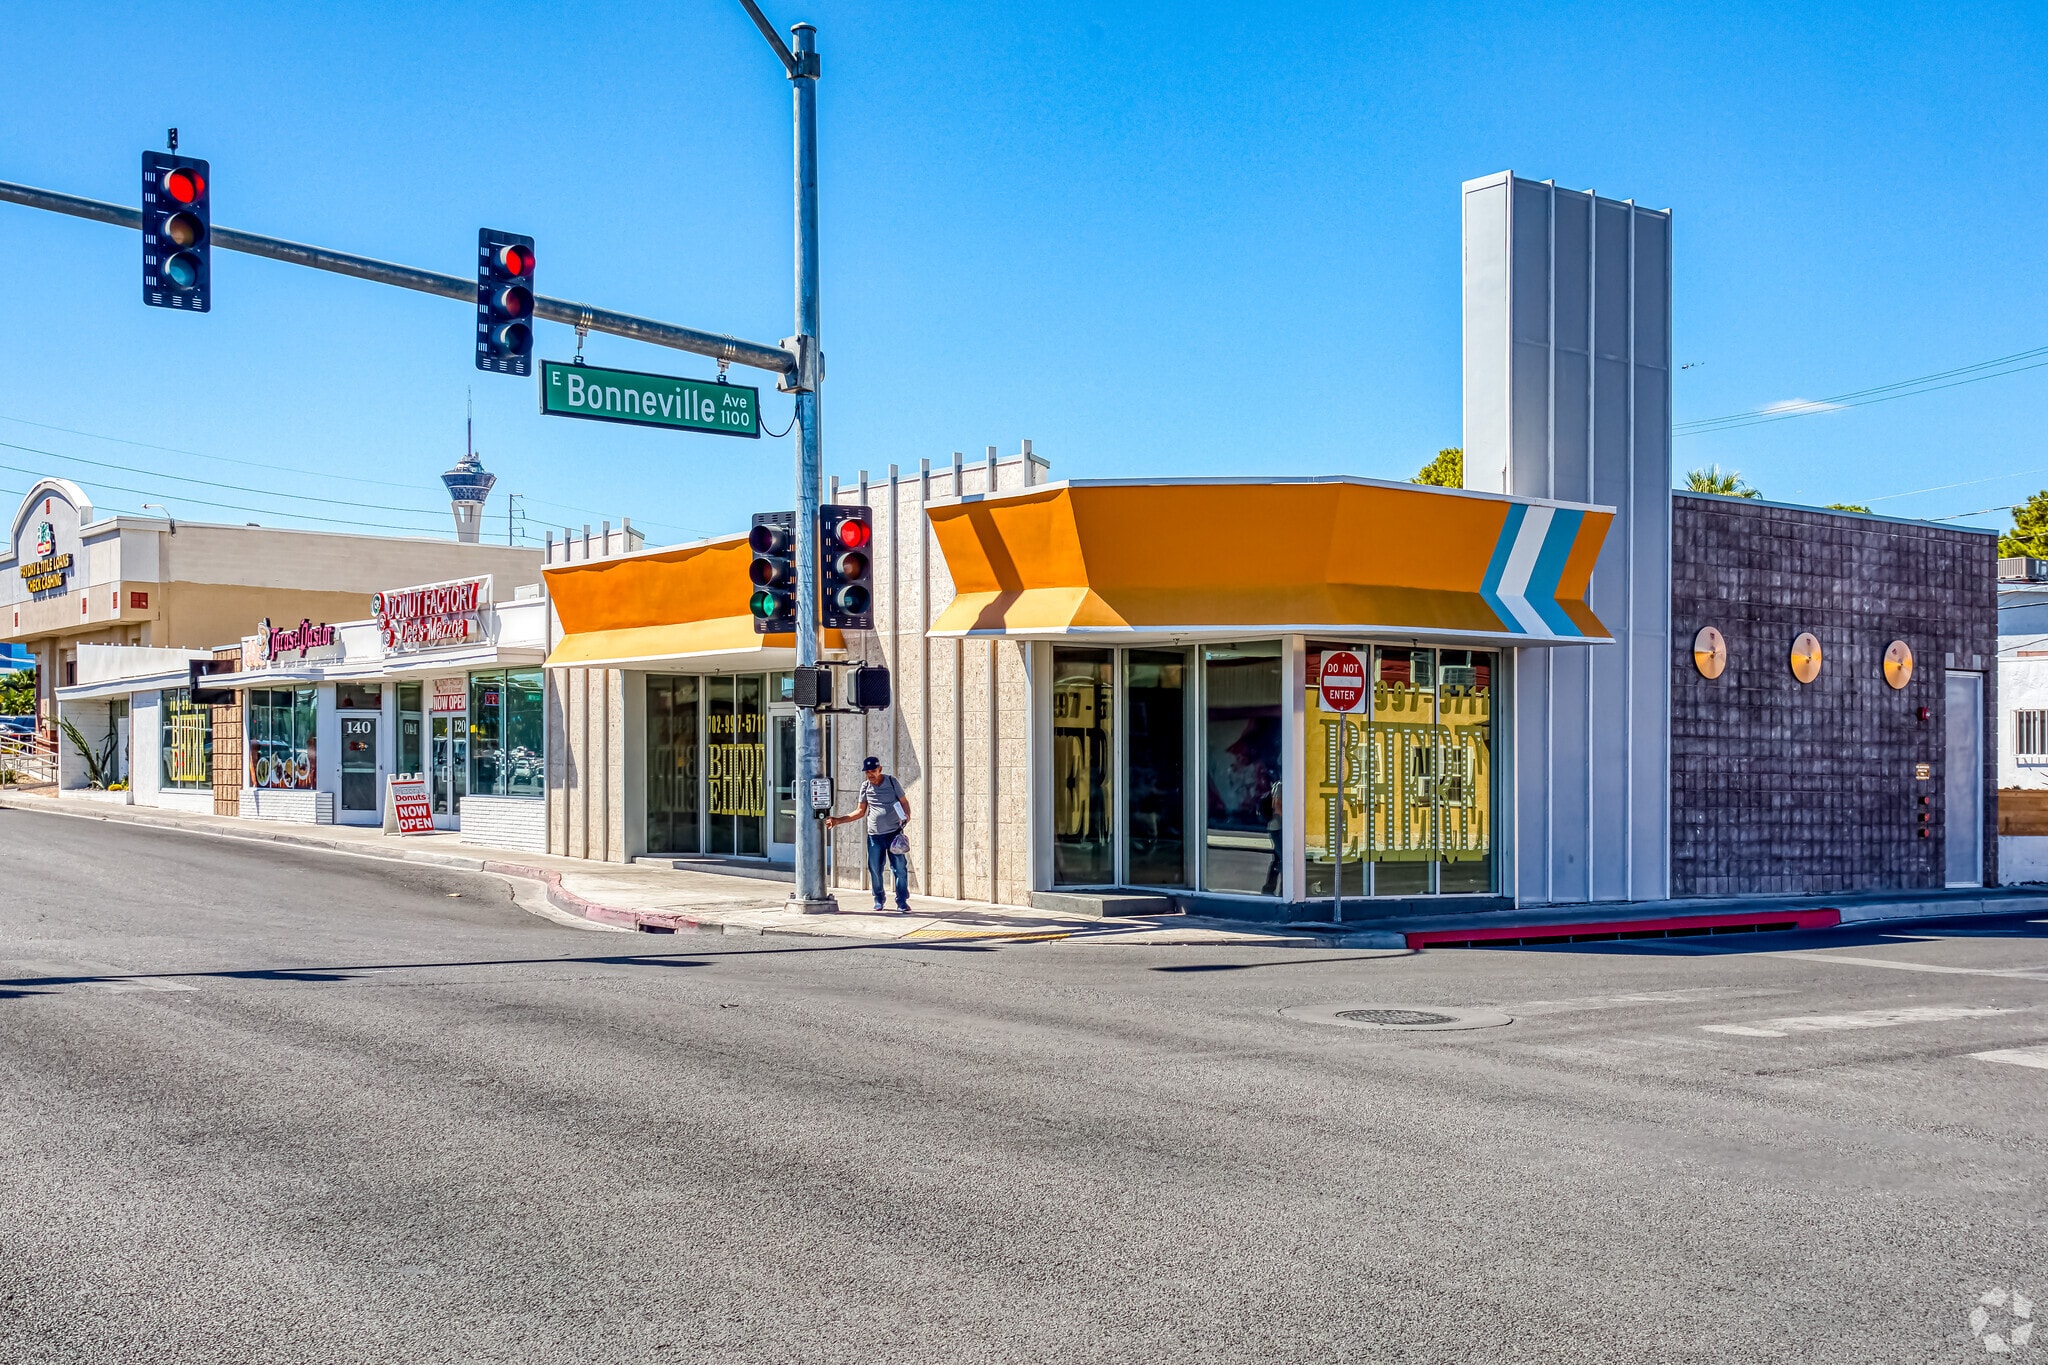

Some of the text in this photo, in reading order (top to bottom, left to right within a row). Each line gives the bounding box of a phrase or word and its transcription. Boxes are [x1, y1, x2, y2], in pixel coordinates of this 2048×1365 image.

[552, 371, 748, 423] E Bonneville Ave
[720, 410, 750, 427] 1100
[20, 562, 37, 579] PAYDAY
[41, 557, 53, 574] TITLE
[53, 553, 69, 570] LOANS
[27, 573, 62, 593] CHECK CASHING
[388, 585, 477, 620] DONUT FACTORY
[1327, 663, 1359, 674] DO NOT
[433, 694, 466, 711] NOW OPEN
[1329, 689, 1355, 701] ENTER
[346, 721, 371, 734] 140
[454, 720, 466, 733] 120
[708, 714, 766, 734] 702-997-5711
[395, 793, 427, 802] Donuts
[398, 805, 427, 818] NOW
[400, 817, 433, 830] OPEN
